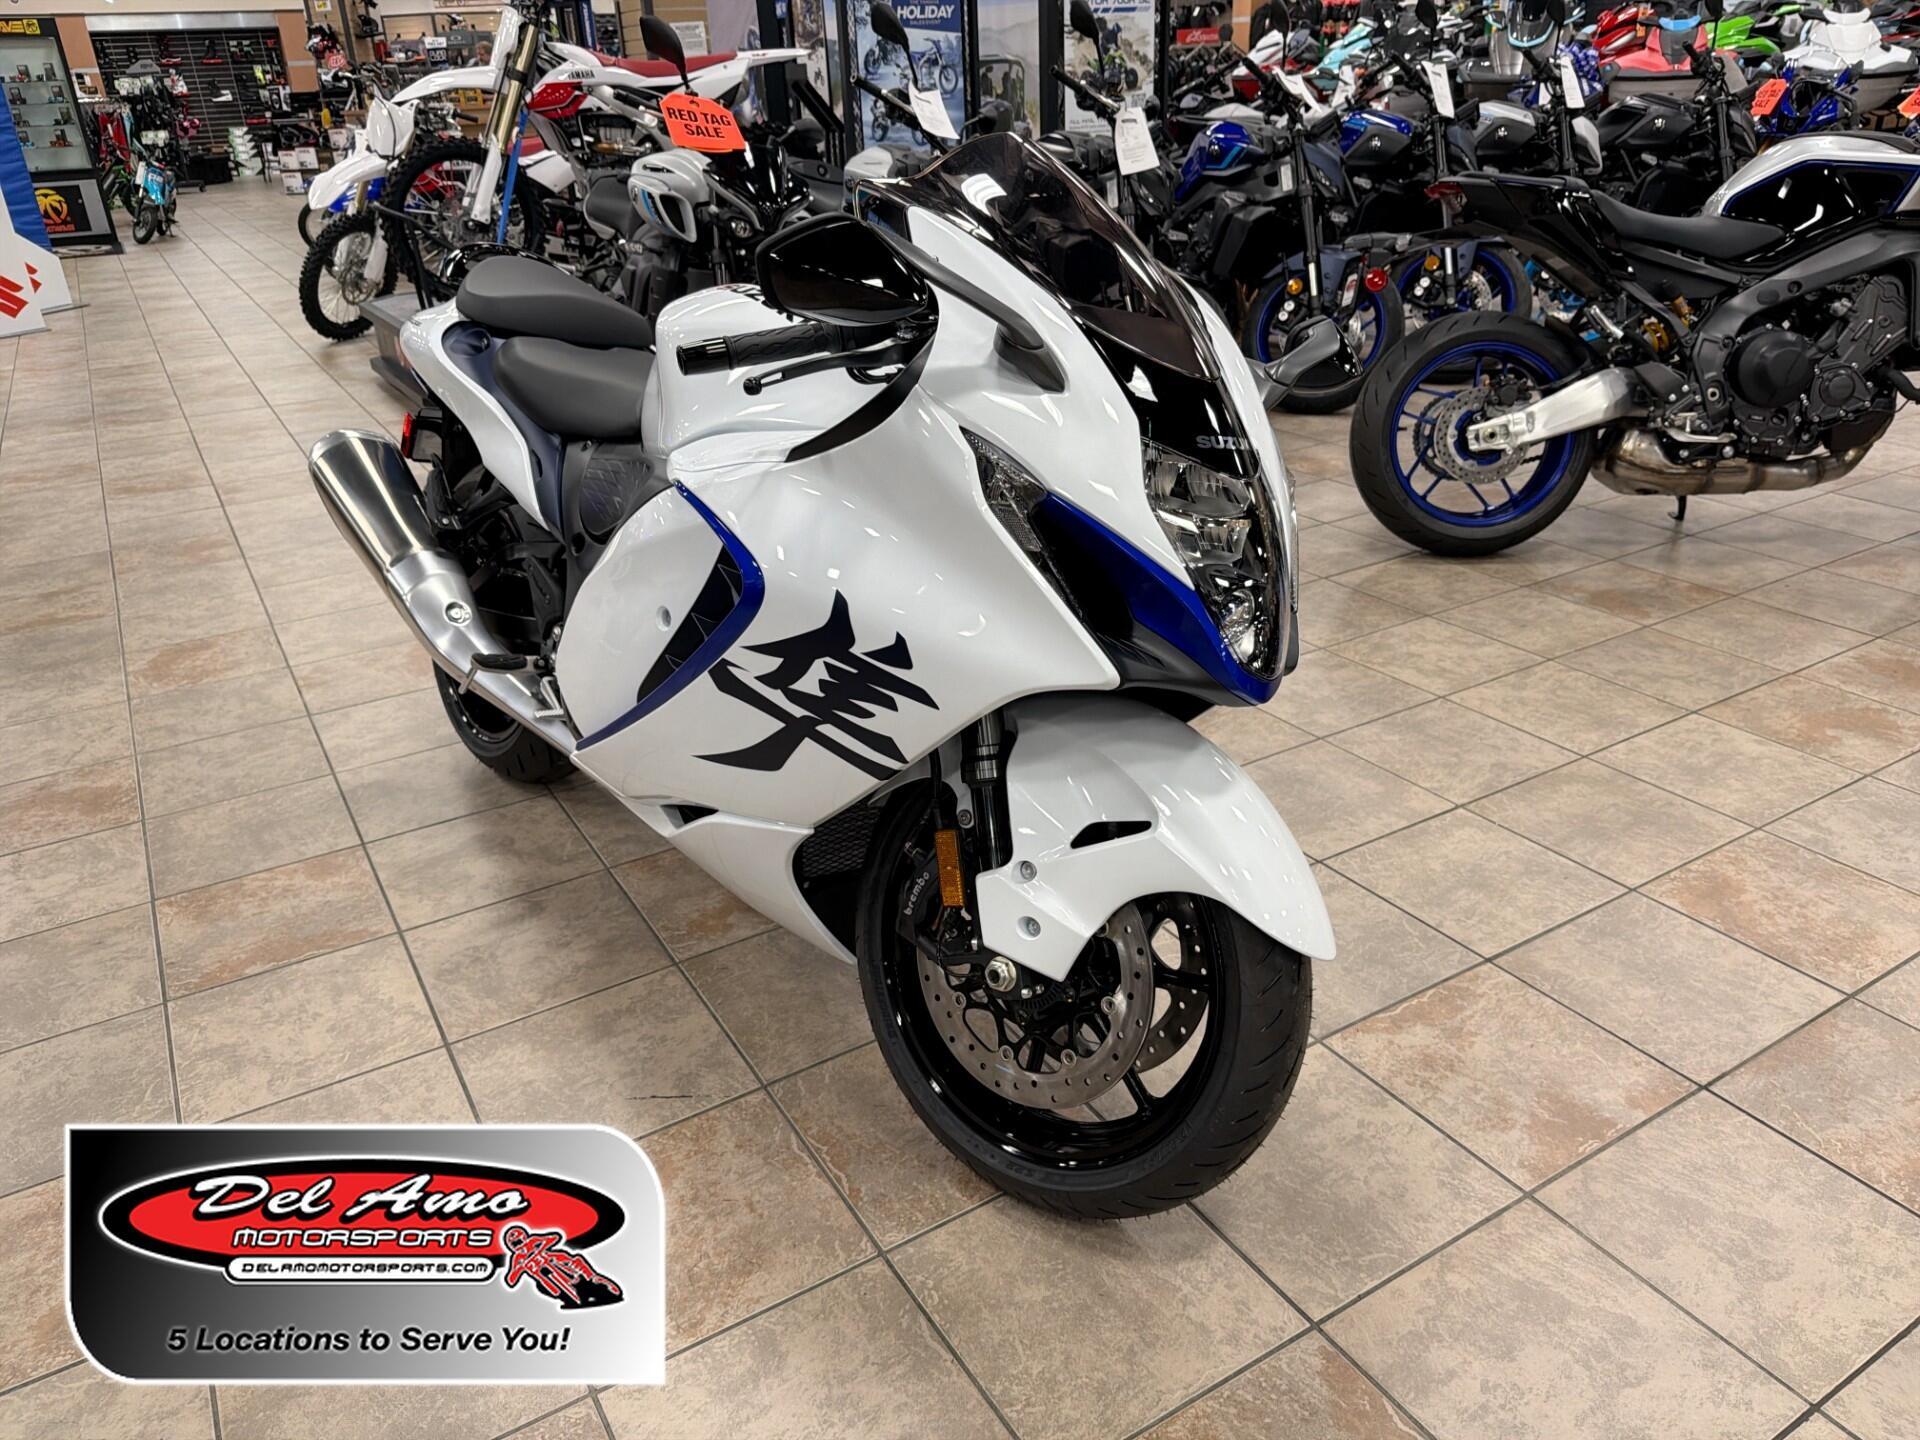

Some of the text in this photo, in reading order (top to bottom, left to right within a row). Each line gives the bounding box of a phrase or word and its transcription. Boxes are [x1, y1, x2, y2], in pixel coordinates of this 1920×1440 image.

[897, 4, 955, 19] HOLIDAY
[567, 70, 595, 80] YAMAHA
[666, 107, 732, 127] RED TAG
[684, 123, 726, 139] SALE
[903, 871, 930, 916] brembo
